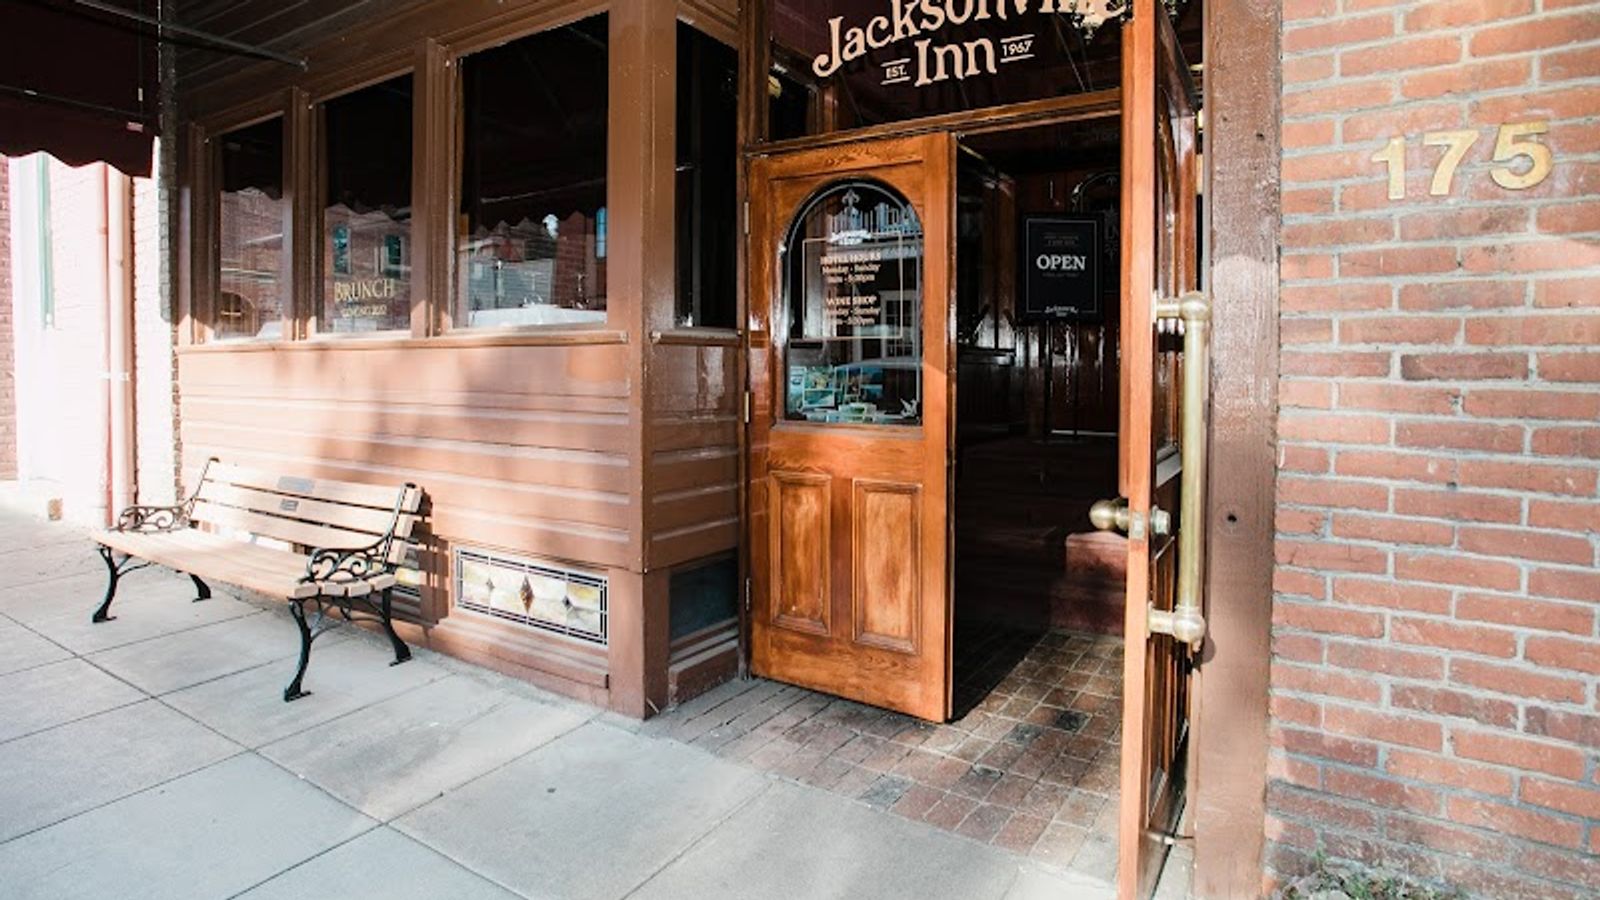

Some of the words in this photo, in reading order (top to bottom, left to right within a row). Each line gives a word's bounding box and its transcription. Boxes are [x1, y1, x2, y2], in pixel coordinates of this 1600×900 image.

[885, 64, 907, 79] EST.
[1002, 40, 1033, 57] 1967
[914, 34, 997, 87] Inn
[1371, 121, 1553, 200] 175
[1036, 254, 1087, 271] OPEN
[334, 278, 394, 303] BRUNCH
[826, 296, 851, 305] WINE
[852, 295, 877, 305] SHOP
